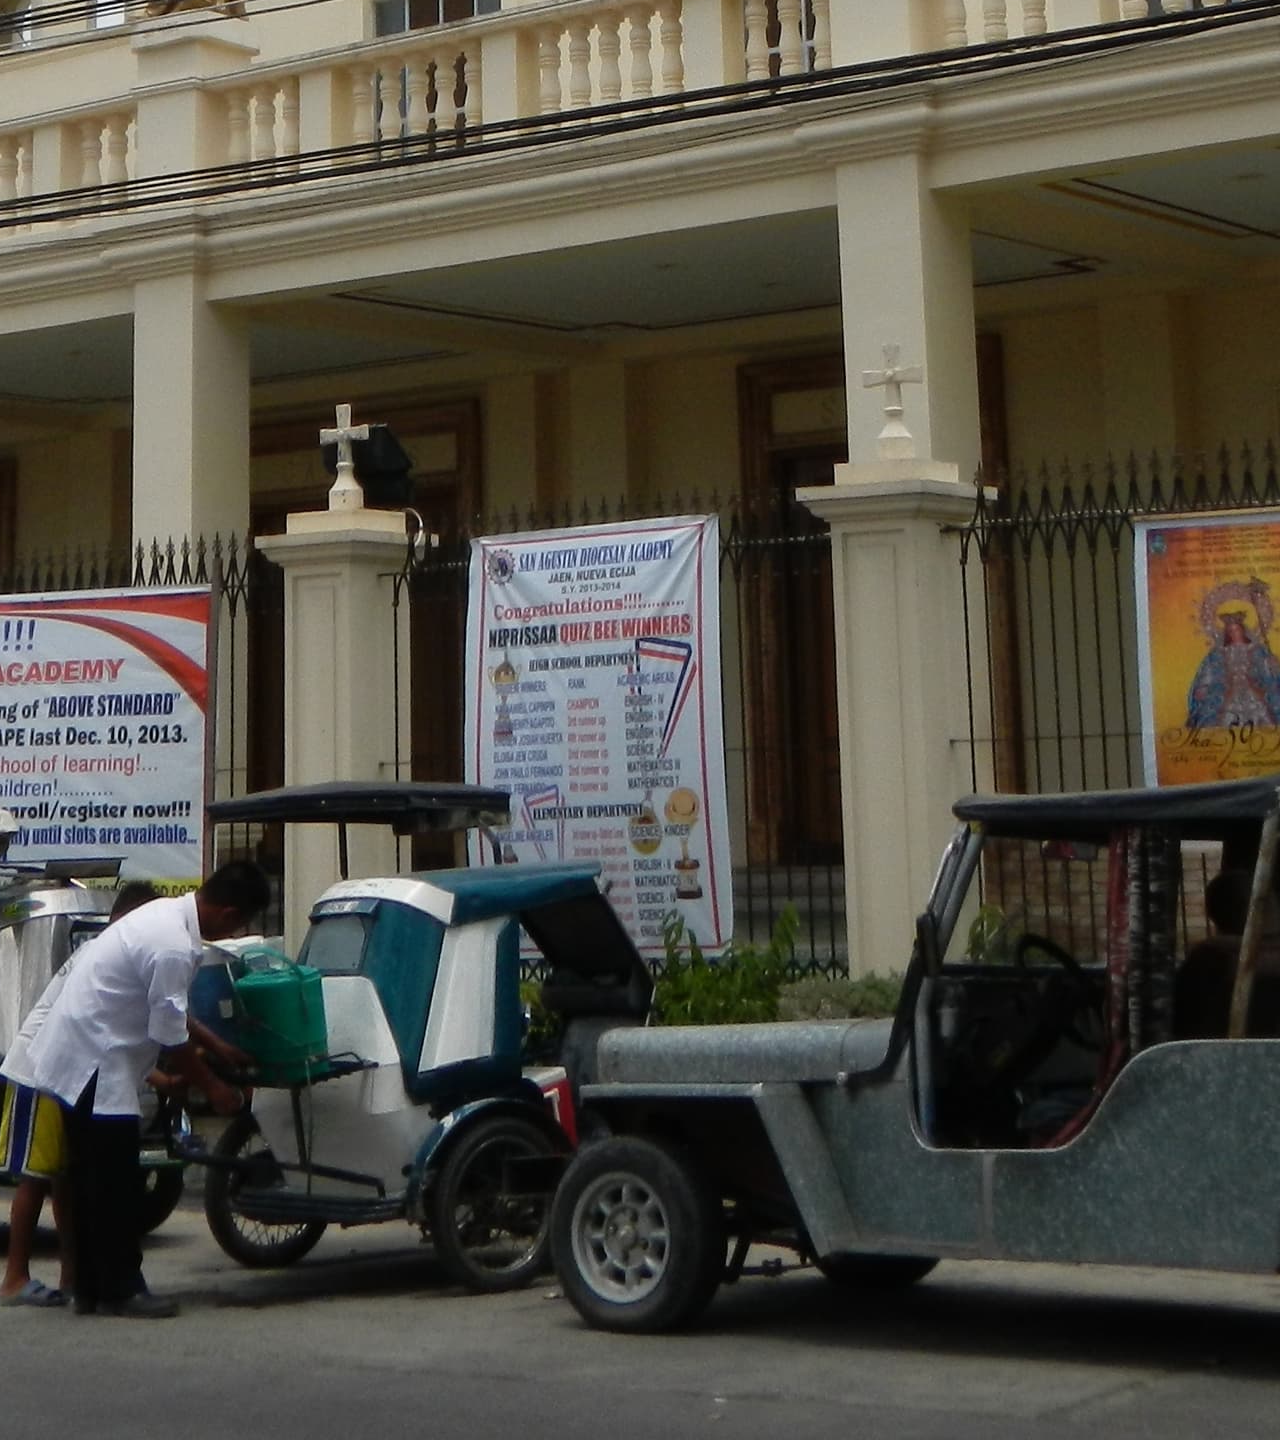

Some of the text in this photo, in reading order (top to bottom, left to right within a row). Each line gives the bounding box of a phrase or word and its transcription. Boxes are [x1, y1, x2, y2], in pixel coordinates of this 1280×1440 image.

[519, 539, 675, 572] SAN AGUSTIN DIOCESAN ACADEMY
[576, 568, 607, 582] NUEVA
[609, 565, 637, 578] ECIJA
[579, 581, 622, 593] 2013-2014
[488, 612, 693, 649] NEPRISSAA QUIZ BEE WINNERS
[551, 655, 583, 671] SCHOOL
[584, 651, 641, 669] DEPARTMENT
[21, 699, 40, 720] of
[28, 726, 61, 747] last
[65, 725, 103, 746] Dec.
[107, 725, 134, 748] 10,
[137, 724, 189, 745] 2013.
[40, 753, 59, 774] of
[131, 799, 192, 819] now!!!
[533, 802, 644, 820] ELEMENTARY DEPARTMENT
[32, 824, 61, 846] until
[63, 824, 96, 846] slots
[98, 828, 121, 845] are
